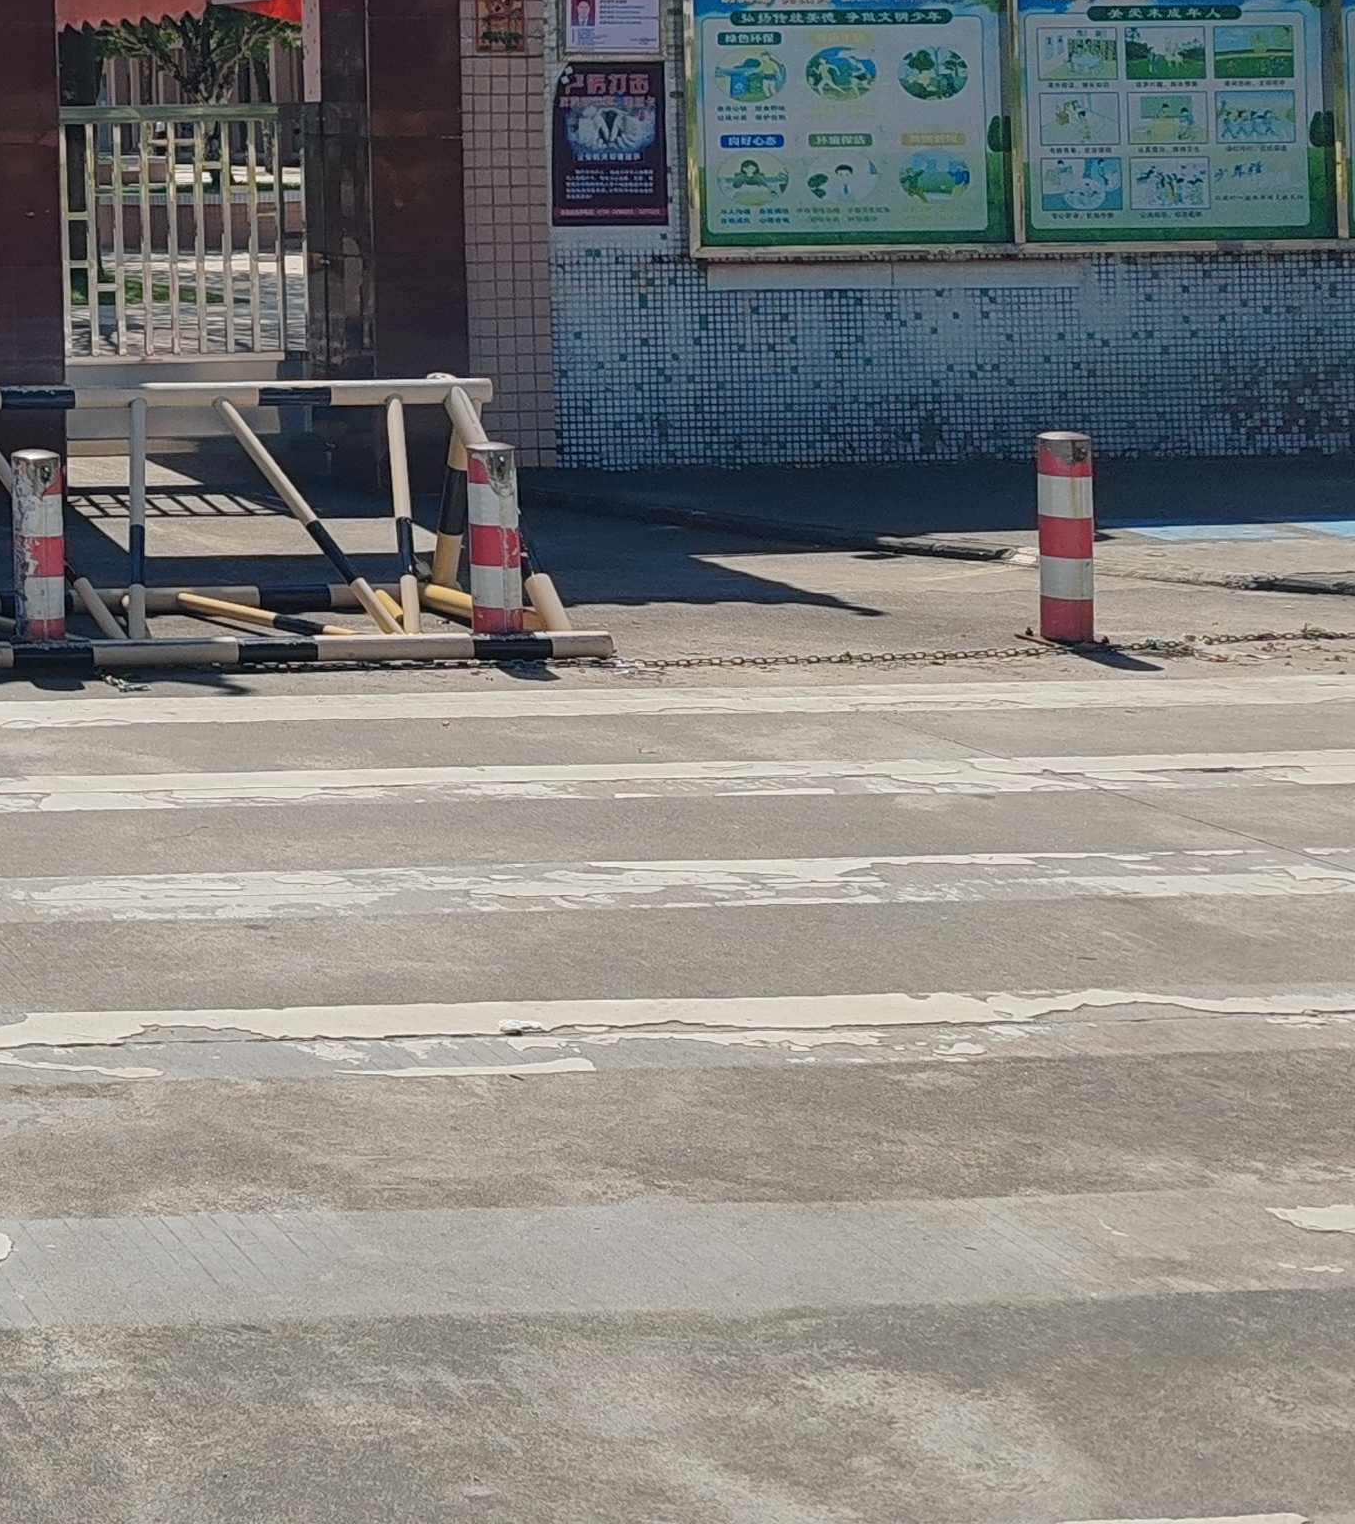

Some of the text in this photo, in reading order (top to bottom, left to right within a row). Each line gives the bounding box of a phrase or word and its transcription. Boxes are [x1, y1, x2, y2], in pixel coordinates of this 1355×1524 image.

[1107, 7, 1222, 19] 关爱未成年人
